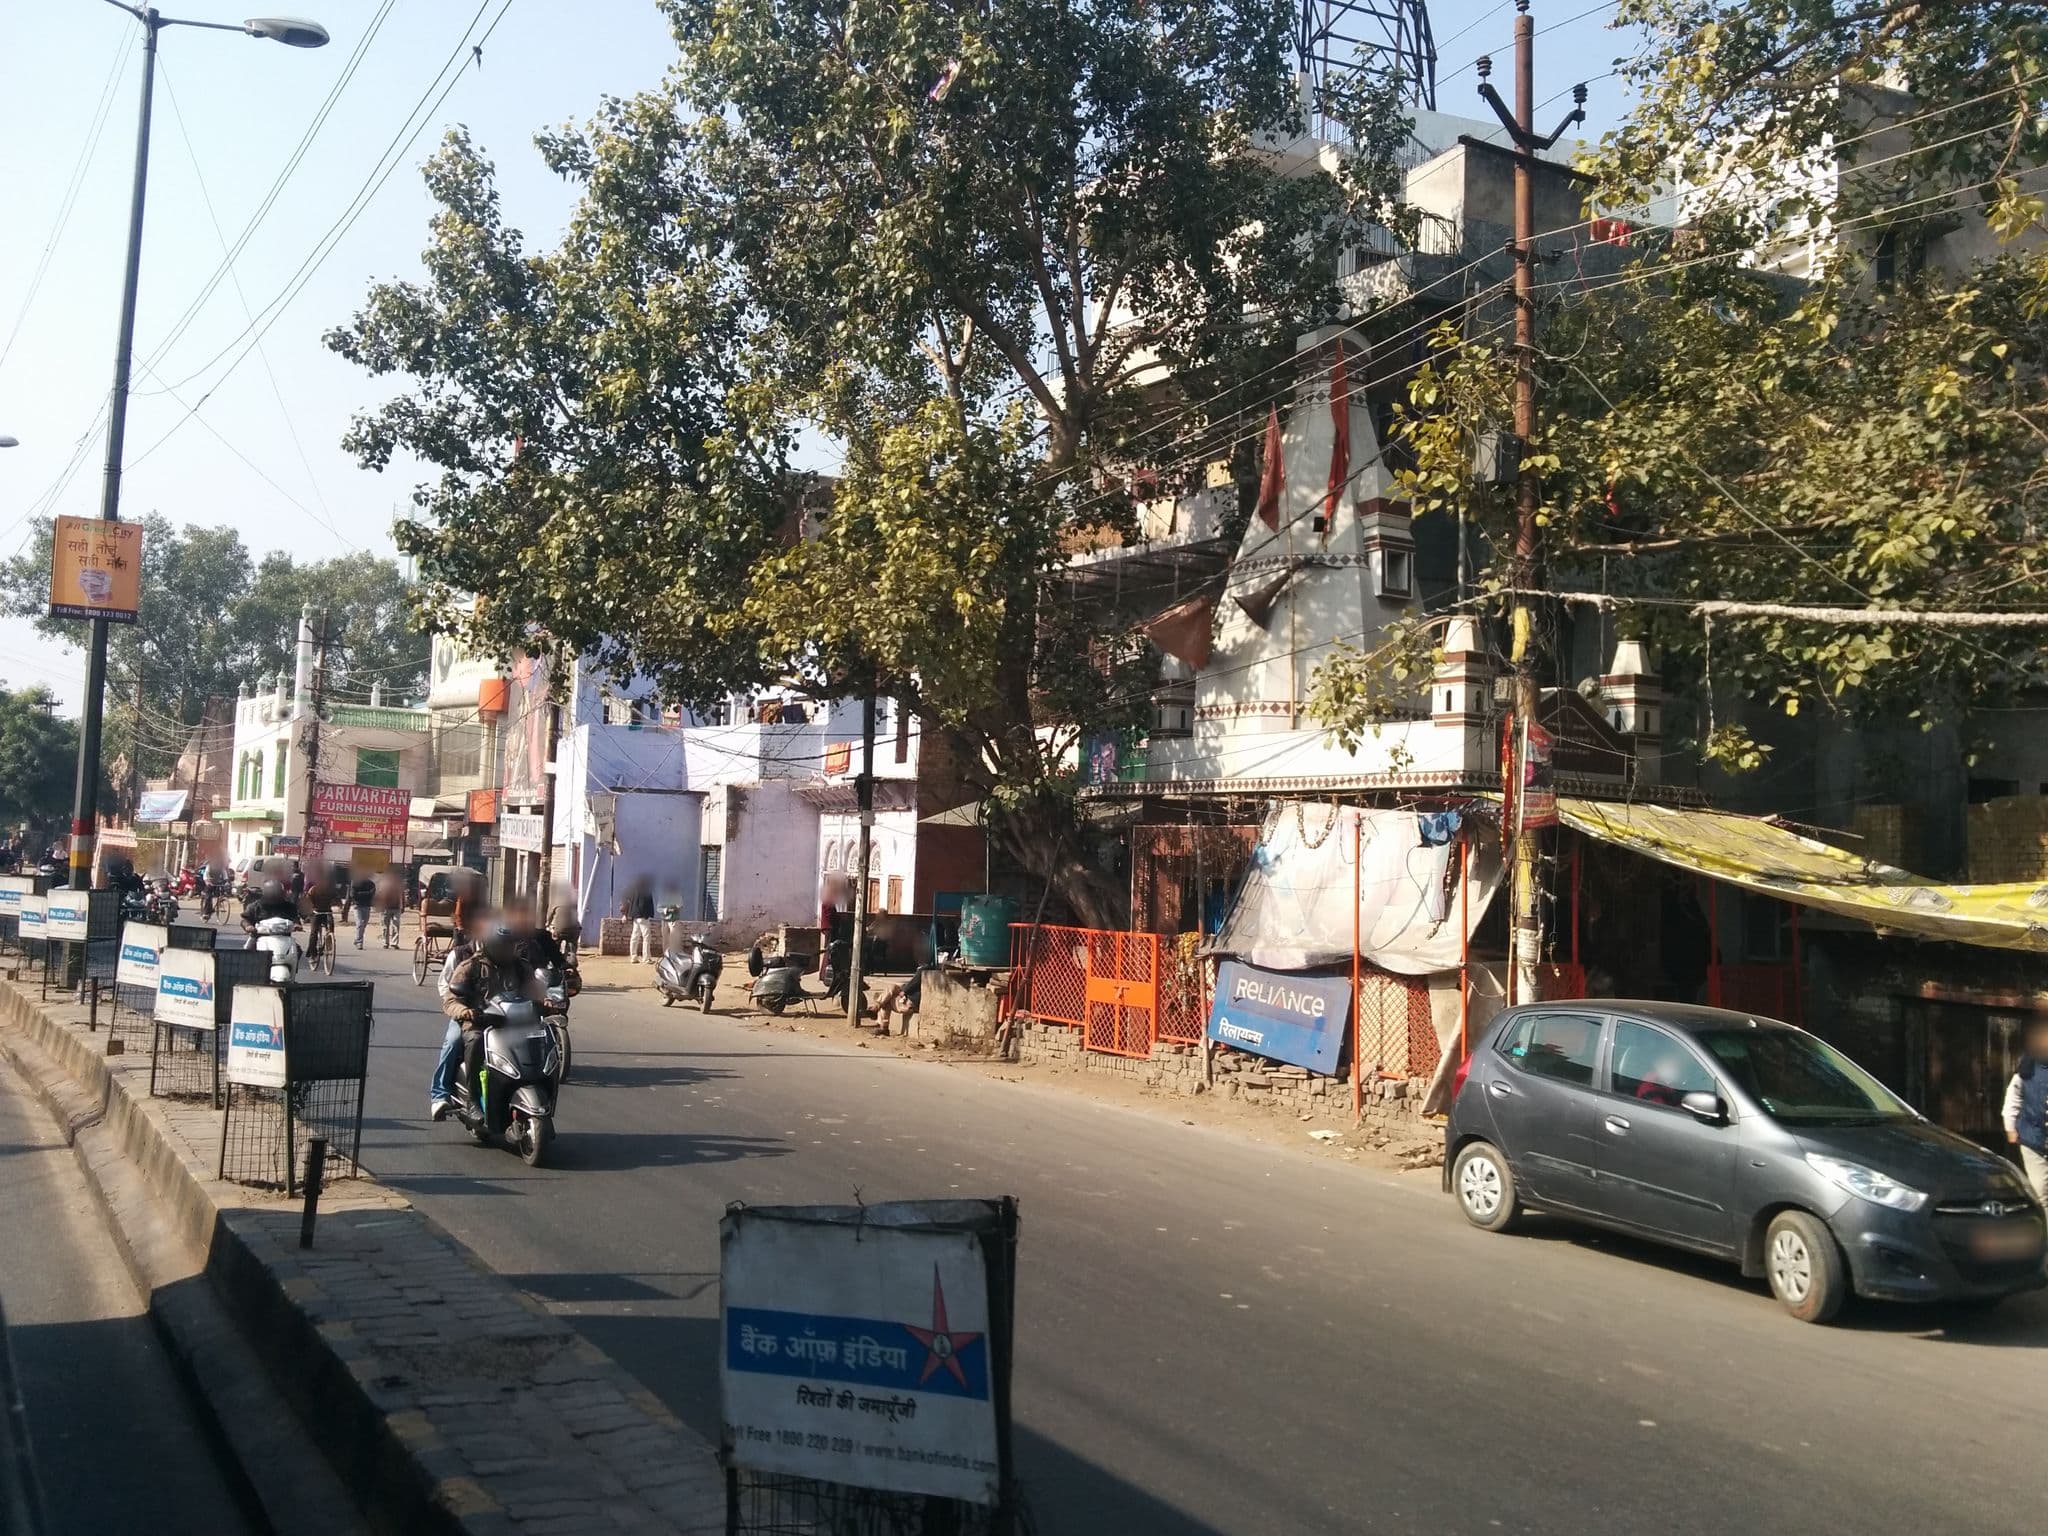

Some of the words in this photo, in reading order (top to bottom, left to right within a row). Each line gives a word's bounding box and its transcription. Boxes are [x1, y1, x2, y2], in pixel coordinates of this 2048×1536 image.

[315, 786, 408, 805] PARIVARTAN
[320, 801, 402, 816] FURNISHINGS
[740, 1322, 779, 1355] बैंक
[842, 1335, 908, 1373] इंडिया
[835, 1389, 855, 1412] की
[746, 1425, 771, 1443] Free
[776, 1428, 803, 1446] 1800
